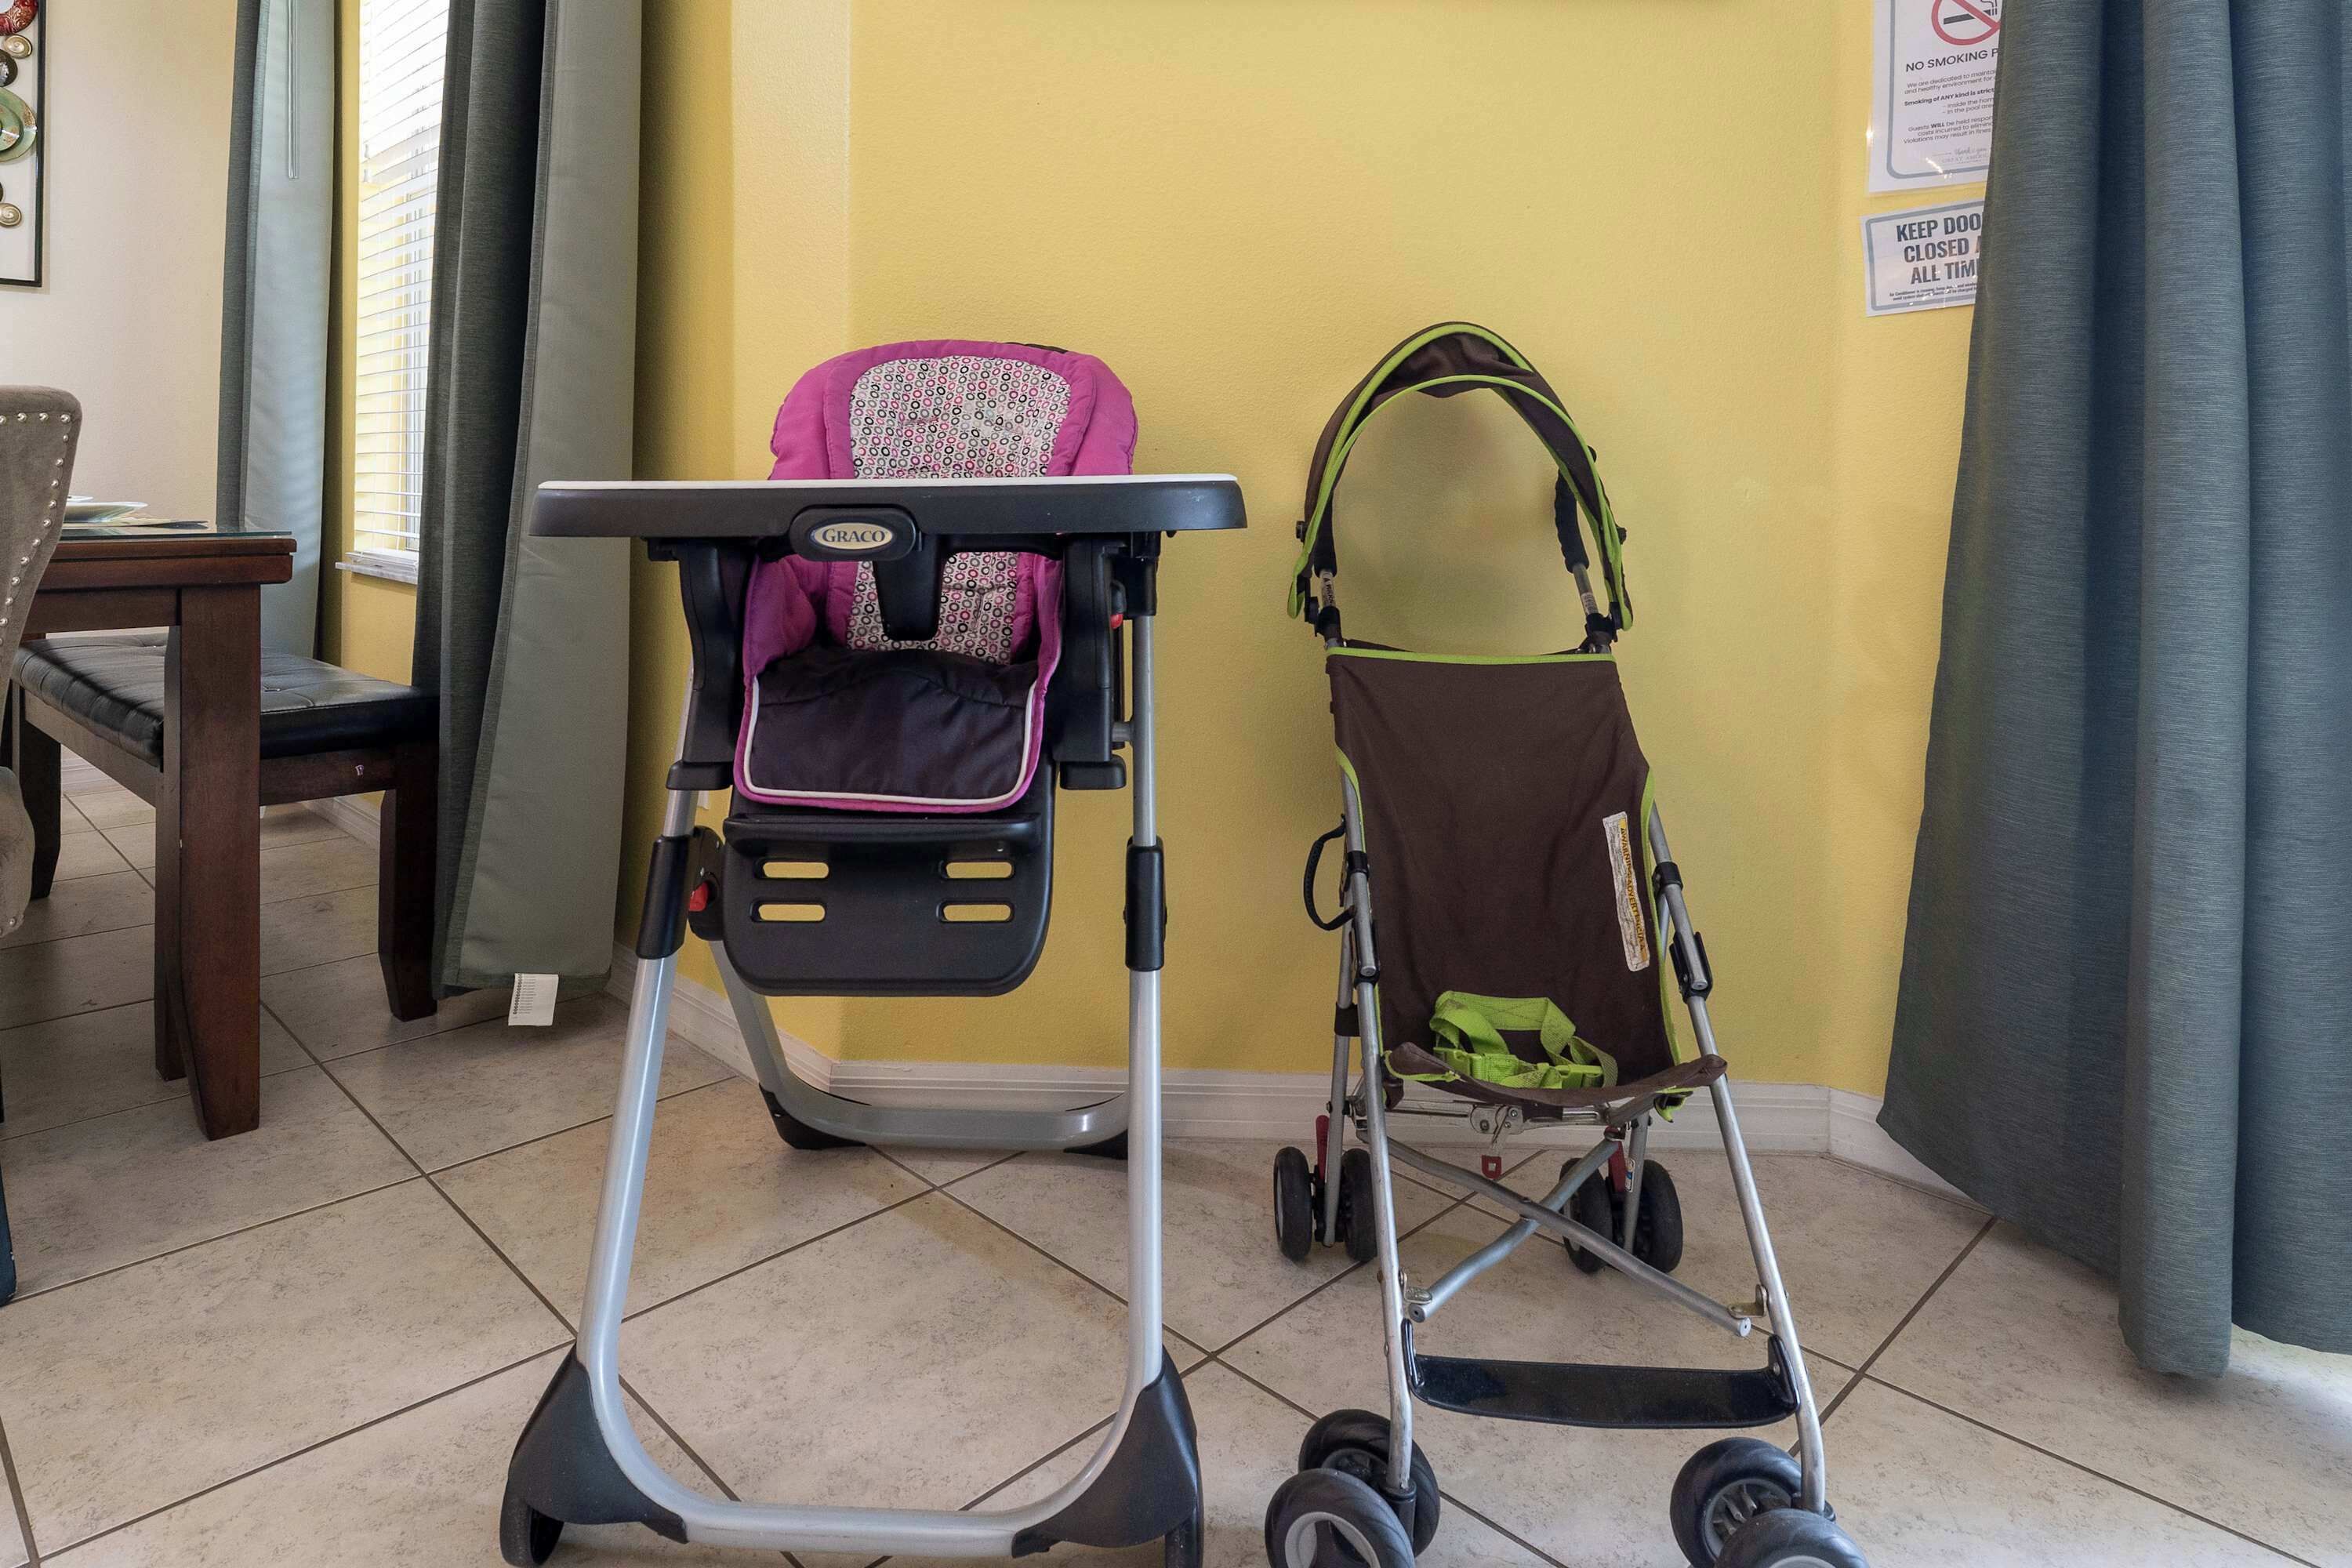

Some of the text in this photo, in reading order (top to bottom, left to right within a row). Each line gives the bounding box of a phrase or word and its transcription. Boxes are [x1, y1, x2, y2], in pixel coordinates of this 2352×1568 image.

[1906, 61, 1924, 72] NO
[1927, 49, 1988, 68] SMOKING
[1930, 75, 1962, 85] dedicated
[1942, 78, 1982, 88] environment
[1904, 98, 1932, 107] Smoking
[1896, 212, 1982, 242] KEEP DOO
[1904, 238, 1969, 263] CLOSED
[1910, 259, 1979, 285] ALL TIM
[822, 528, 885, 543] GRACO
